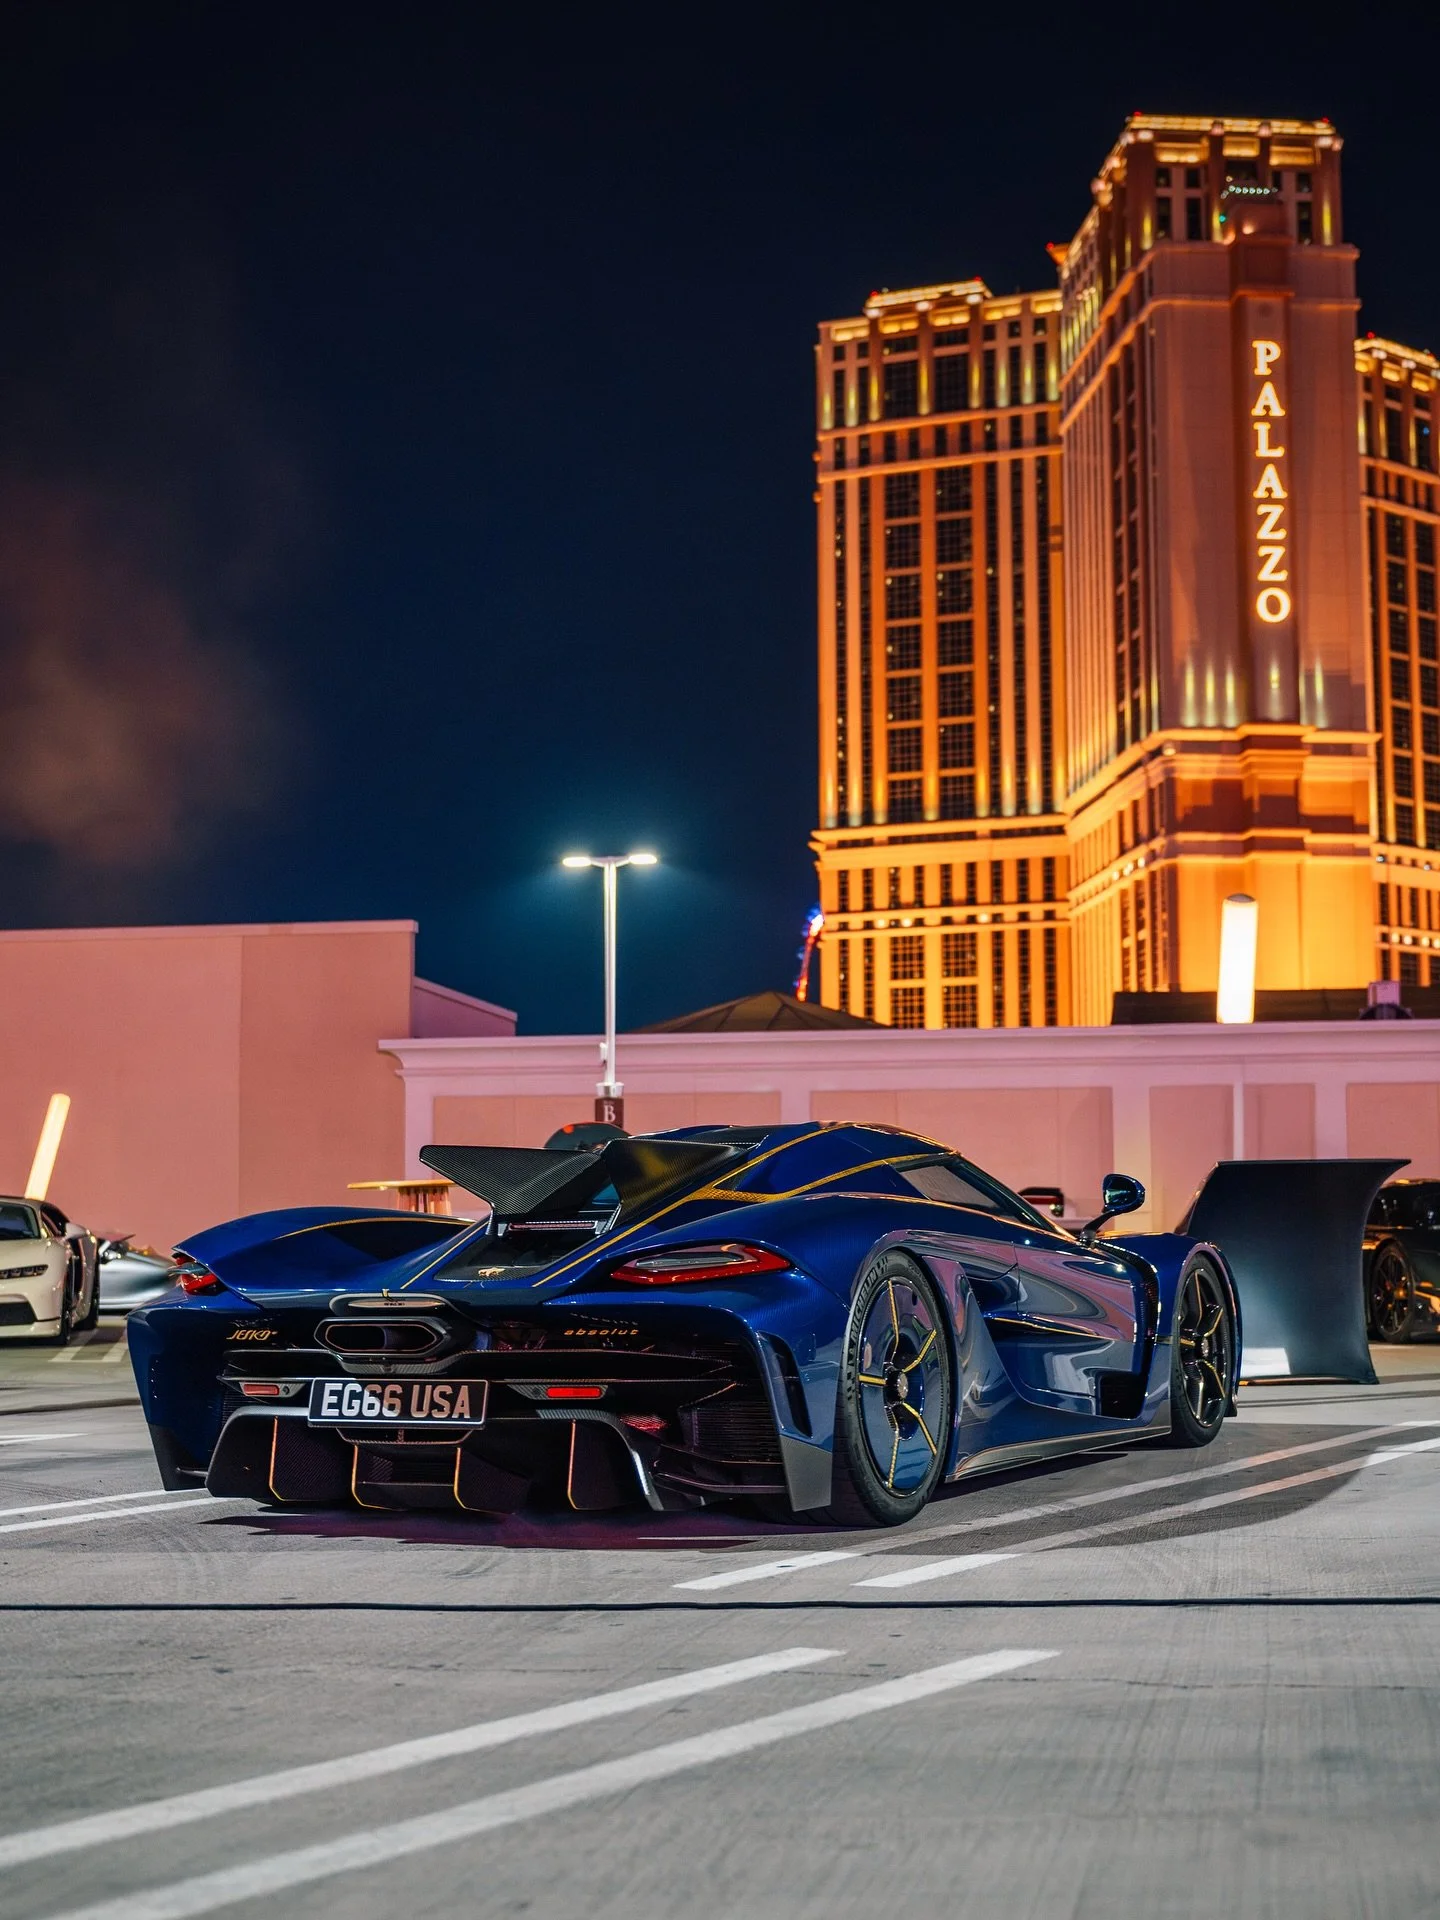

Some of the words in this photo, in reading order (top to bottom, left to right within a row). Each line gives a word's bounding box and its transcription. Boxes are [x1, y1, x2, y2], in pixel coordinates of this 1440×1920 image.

[1251, 340, 1291, 623] PALAZZO
[604, 1105, 616, 1122] B
[850, 1267, 878, 1343] MICHELIN
[226, 1329, 271, 1341] JESKO
[563, 1328, 639, 1336] absolut
[321, 1383, 403, 1418] EG66
[410, 1384, 471, 1419] USA
